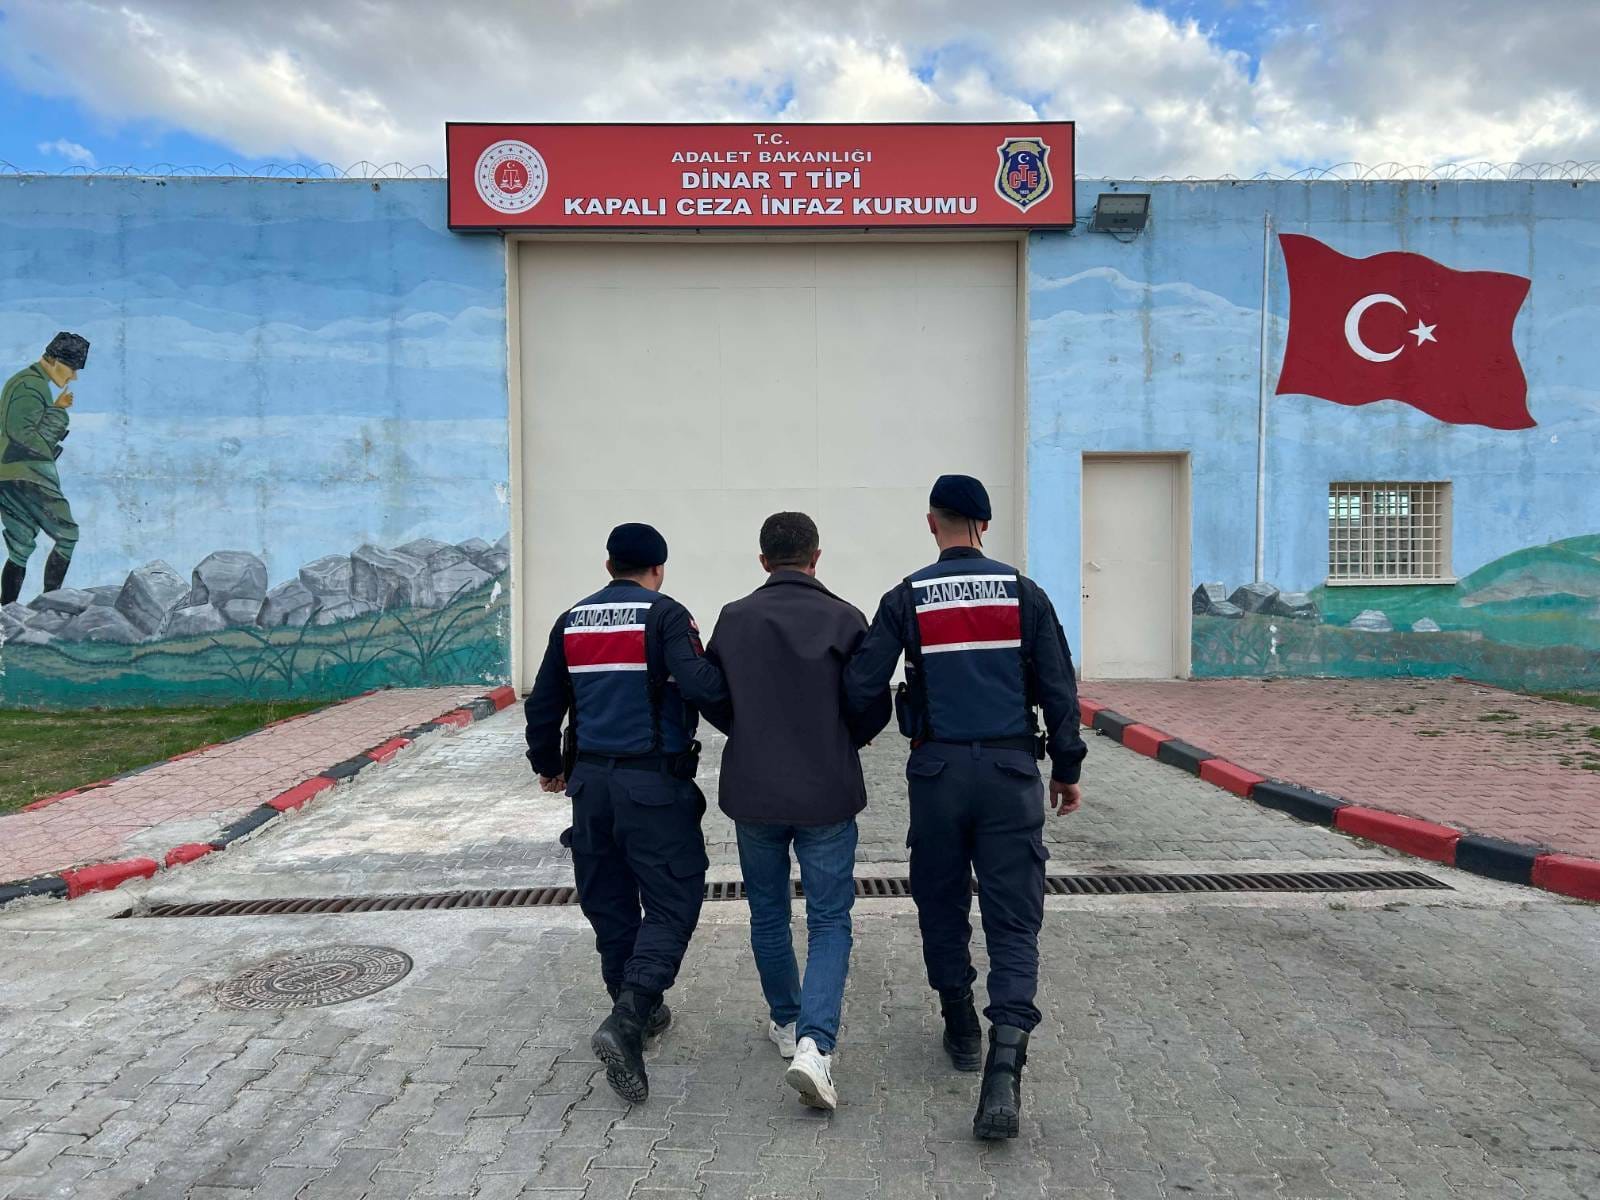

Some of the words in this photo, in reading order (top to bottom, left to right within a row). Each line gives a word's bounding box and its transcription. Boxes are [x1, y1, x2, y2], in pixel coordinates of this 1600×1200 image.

[753, 133, 790, 145] T.C.
[671, 151, 751, 163] ADALET
[759, 148, 872, 163] BAKANLIĞI
[682, 168, 771, 189] DİNAR
[778, 172, 797, 188] T
[805, 168, 861, 188] TİPİ
[564, 198, 666, 216] KAPALI
[676, 198, 752, 216] CEZA
[761, 194, 844, 215] İNFAZ
[853, 197, 977, 214] KURUMU
[922, 581, 1009, 604] JANDARMA
[570, 608, 637, 627] JANDARMA
